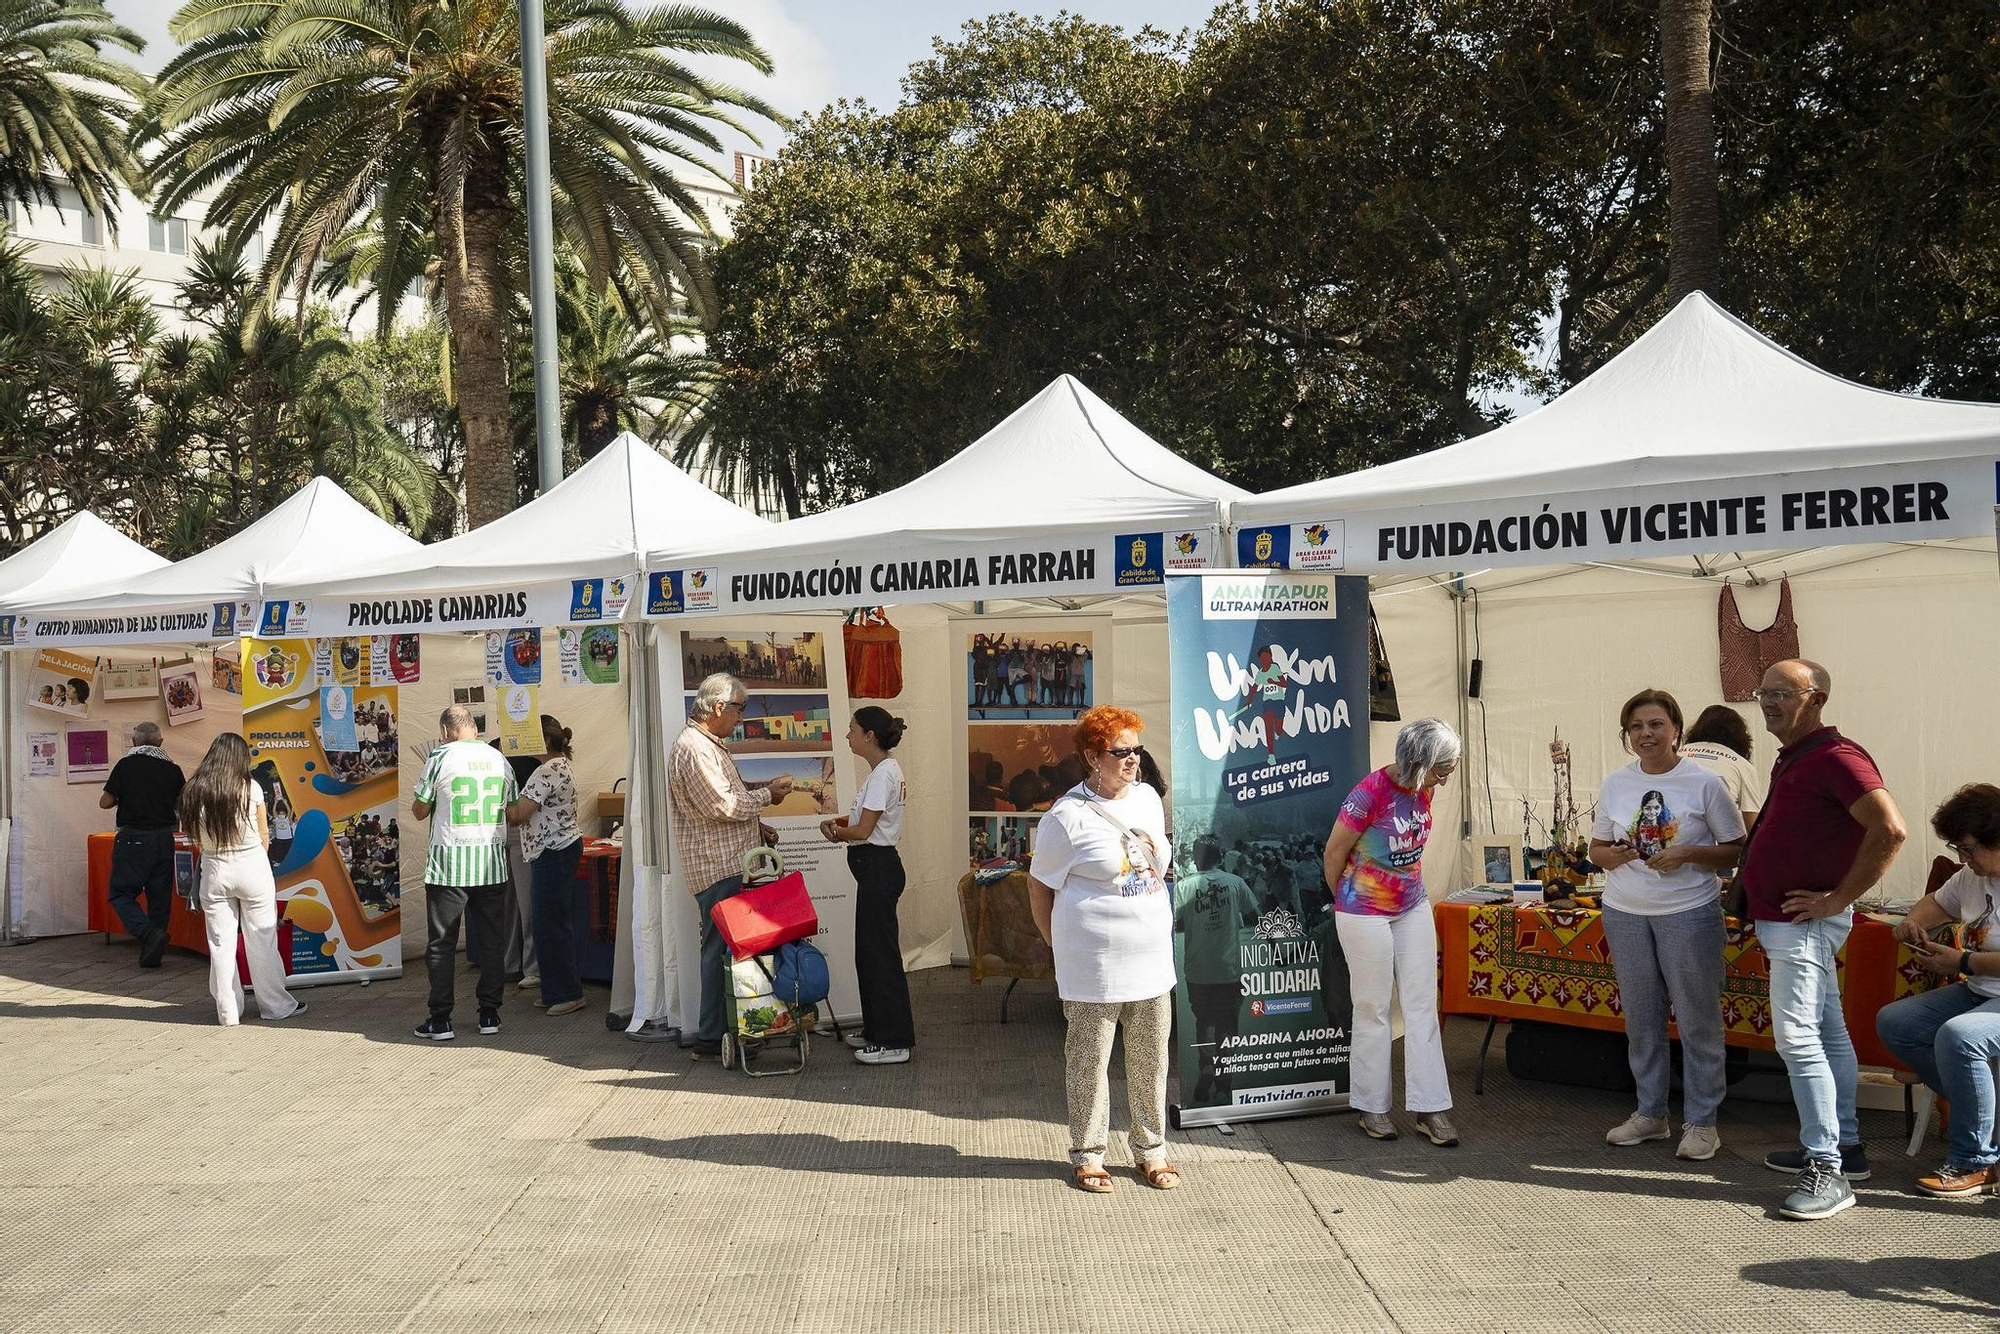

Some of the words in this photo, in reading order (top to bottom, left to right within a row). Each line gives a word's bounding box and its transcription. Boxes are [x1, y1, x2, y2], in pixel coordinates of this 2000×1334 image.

[1378, 504, 1587, 561] FUNDACIÓN
[1600, 495, 1766, 544] VICENTE
[1782, 482, 1950, 531] FERRER
[731, 560, 862, 602] FUNDACIÓN
[870, 557, 980, 593] CANARIA
[989, 548, 1095, 586] FARRAH
[1121, 569, 1143, 577] Cabildo
[1135, 575, 1160, 583] Canaria
[1212, 585, 1329, 599] ANANTAPUR
[348, 599, 433, 626] PROCLADE
[439, 591, 527, 622] CANARIAS
[1210, 600, 1329, 612] ULTRAMARATHON
[35, 620, 70, 636] CENTRO
[71, 618, 124, 635] HUMANISTA
[126, 617, 139, 633] DE
[140, 616, 158, 632] LAS
[160, 613, 208, 631] CULTURAS
[40, 653, 94, 675] RELAJACIÓN
[250, 731, 305, 739] PROCLADE
[257, 740, 310, 749] CANARIAS
[1679, 748, 1738, 762] OLUNTARIADO
[468, 761, 492, 771] ISCO
[1228, 772, 1247, 786] La
[1251, 759, 1307, 781] carrera
[1237, 786, 1256, 801] de
[1260, 781, 1284, 796] sus
[1288, 771, 1330, 789] vidas
[450, 775, 505, 827] 22
[1240, 940, 1320, 968] INICIATIVA
[1240, 968, 1321, 997] SOLIDARIA
[1266, 1001, 1310, 1011] VicenteFerrer
[1220, 1031, 1292, 1049] APADRINA
[1296, 1027, 1344, 1042] AHORA
[1212, 1056, 1219, 1065] Y
[1221, 1053, 1263, 1065] ayúdanos
[1274, 1051, 1290, 1061] que
[1292, 1048, 1314, 1058] miles
[1316, 1046, 1327, 1055] de
[1329, 1044, 1351, 1054] niñas
[1215, 1067, 1221, 1076] y
[1223, 1064, 1247, 1074] niños
[1249, 1062, 1279, 1073] tengan
[1294, 1057, 1320, 1069] futuro
[1322, 1055, 1349, 1066] mejor.
